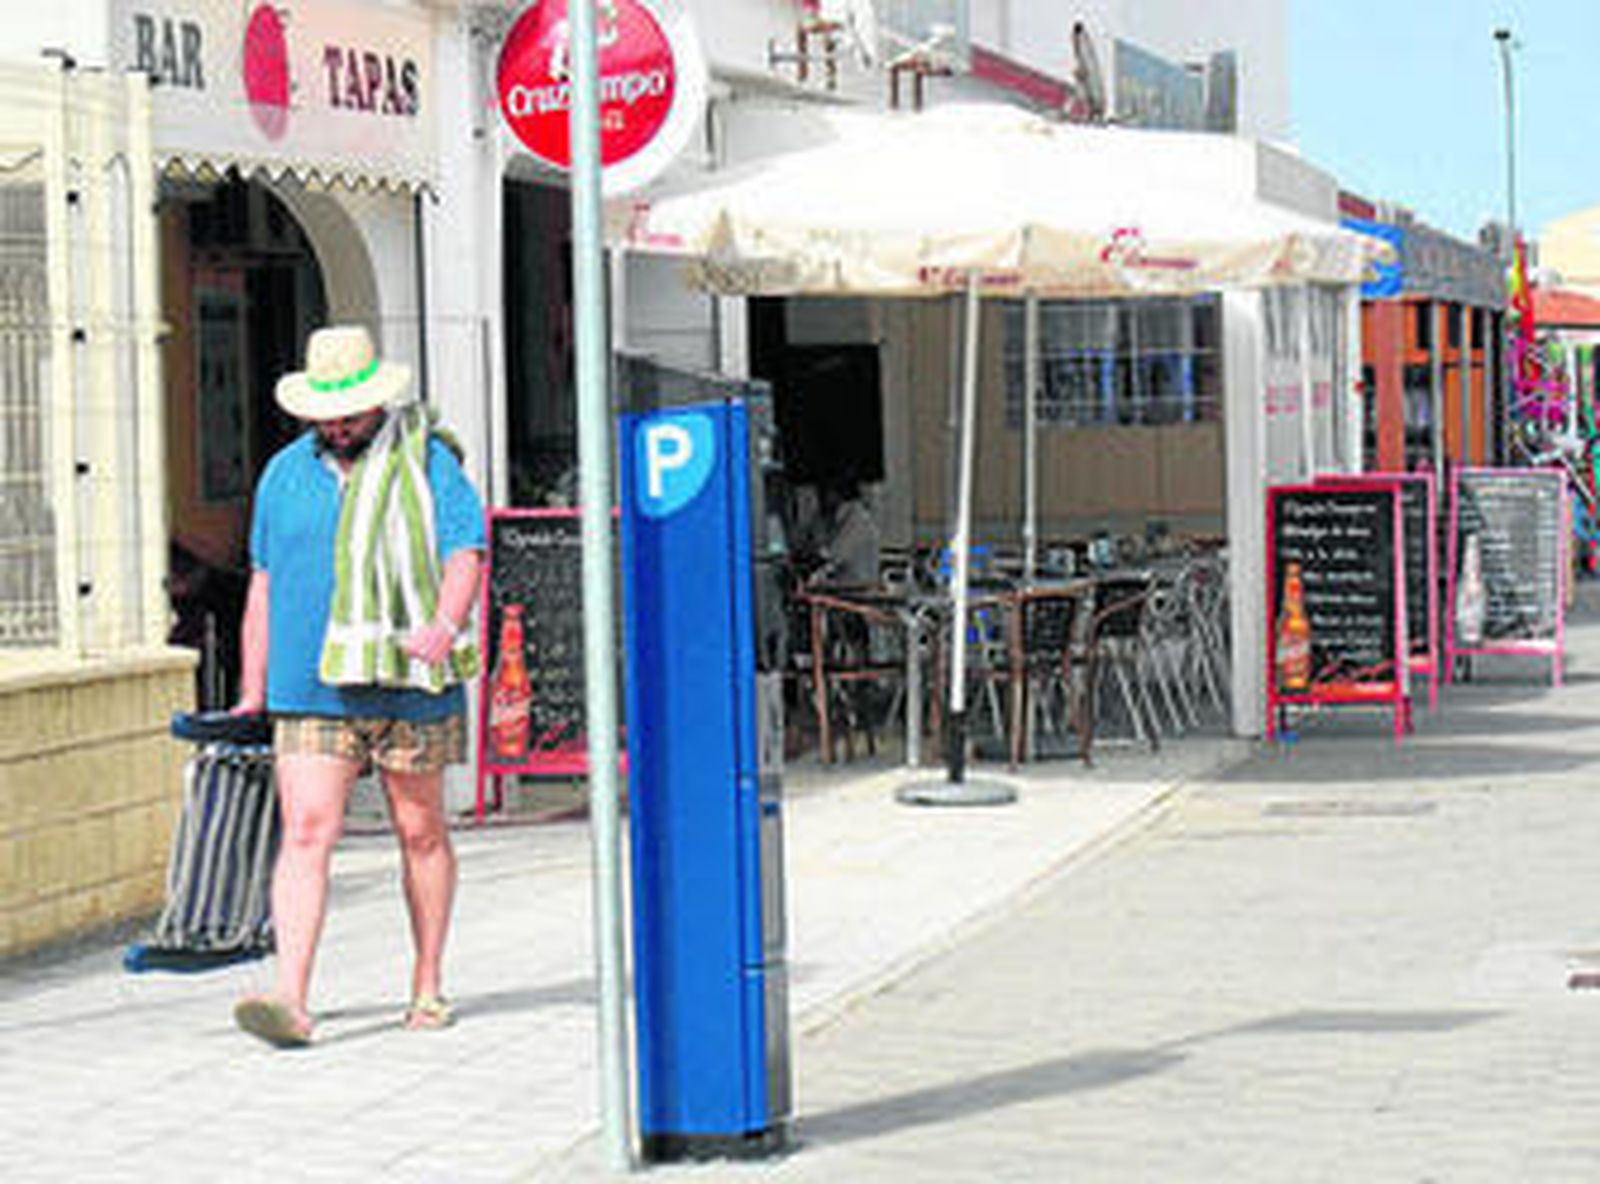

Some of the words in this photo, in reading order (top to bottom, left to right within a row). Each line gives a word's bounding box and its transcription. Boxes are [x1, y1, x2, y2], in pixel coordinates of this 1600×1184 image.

[132, 13, 206, 91] BAR
[323, 45, 420, 116] TAPAS
[646, 422, 694, 498] P
